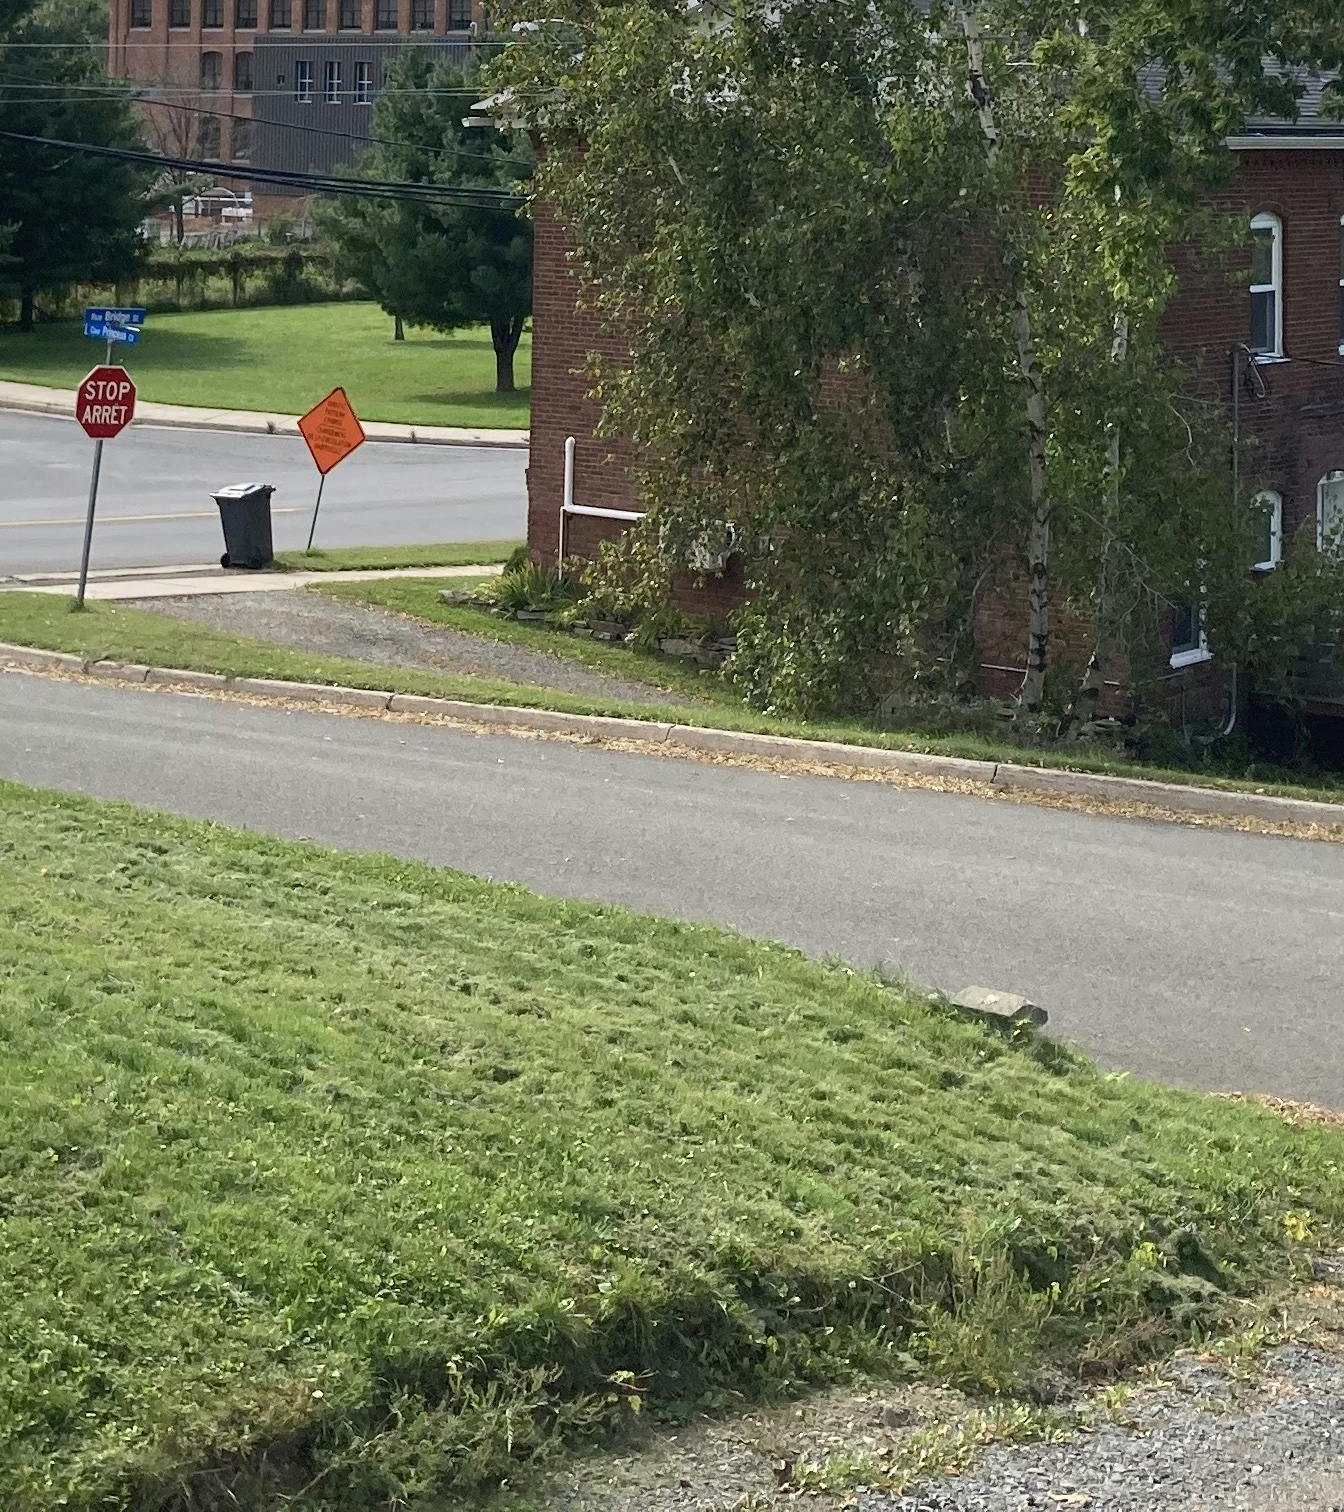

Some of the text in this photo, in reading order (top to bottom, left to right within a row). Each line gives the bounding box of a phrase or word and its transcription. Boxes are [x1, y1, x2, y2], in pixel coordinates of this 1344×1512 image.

[104, 311, 131, 324] Bridge
[84, 380, 131, 401] STOP
[81, 403, 128, 425] ARRÊT
